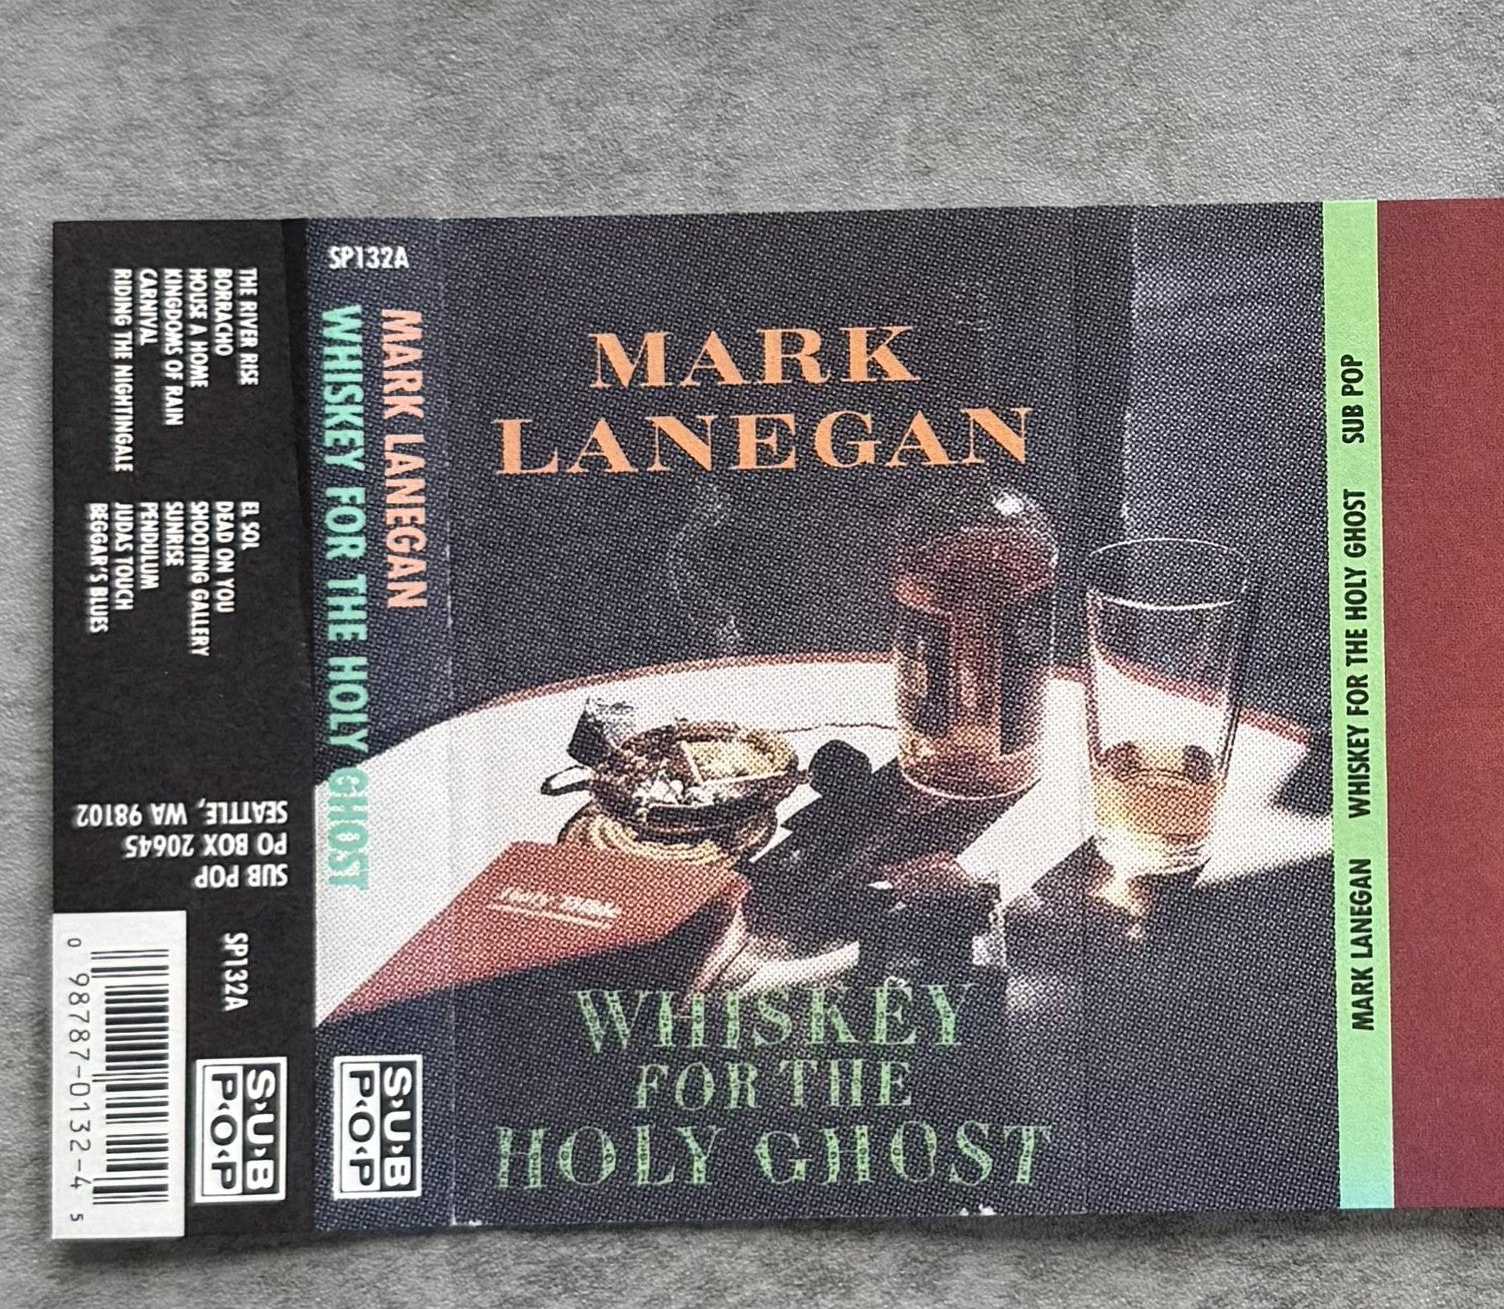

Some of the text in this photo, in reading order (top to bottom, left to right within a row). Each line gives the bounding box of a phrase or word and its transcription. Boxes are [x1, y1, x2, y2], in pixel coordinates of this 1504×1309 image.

[328, 244, 411, 271] SP132A
[138, 268, 159, 346] CARNIVAL
[163, 268, 184, 426] KINGDOMS OF RAIN
[188, 268, 209, 388] HOUSE A HOME
[213, 267, 234, 357] BORRACHO
[238, 267, 259, 386] THE RIVER RISE
[111, 268, 134, 472] RIDING THE NIGHTINGALE
[588, 325, 920, 389] MARK
[381, 308, 428, 609] MARK LANEGAN
[491, 406, 1034, 475] LANEGAN
[113, 501, 134, 610] JUDAS TOUCH
[139, 501, 160, 590] PENDULUM
[164, 501, 185, 567] SUNRISE
[214, 500, 235, 613] DEAD ON YOU
[240, 501, 261, 551] EL SOL
[88, 502, 109, 633] BEGGAR'S BLUES
[189, 500, 210, 657] SHOOTING GALLERY
[320, 305, 370, 891] WHISKEY FOR THE HOLY GHOST
[1340, 354, 1375, 1031] MARK LANEGAN WHISKEY FOR THE HOLY GHOST SUB POP
[75, 797, 288, 828] SEATTLE, WA 98102
[124, 832, 288, 859] PO BOX 20645
[193, 863, 288, 889] SUB POP
[67, 938, 83, 949] 0
[222, 931, 250, 1012] SP132A
[577, 983, 978, 1054] WHISKEY
[634, 1059, 913, 1111] FOR THE
[493, 1119, 1054, 1190] HOLY GHOST
